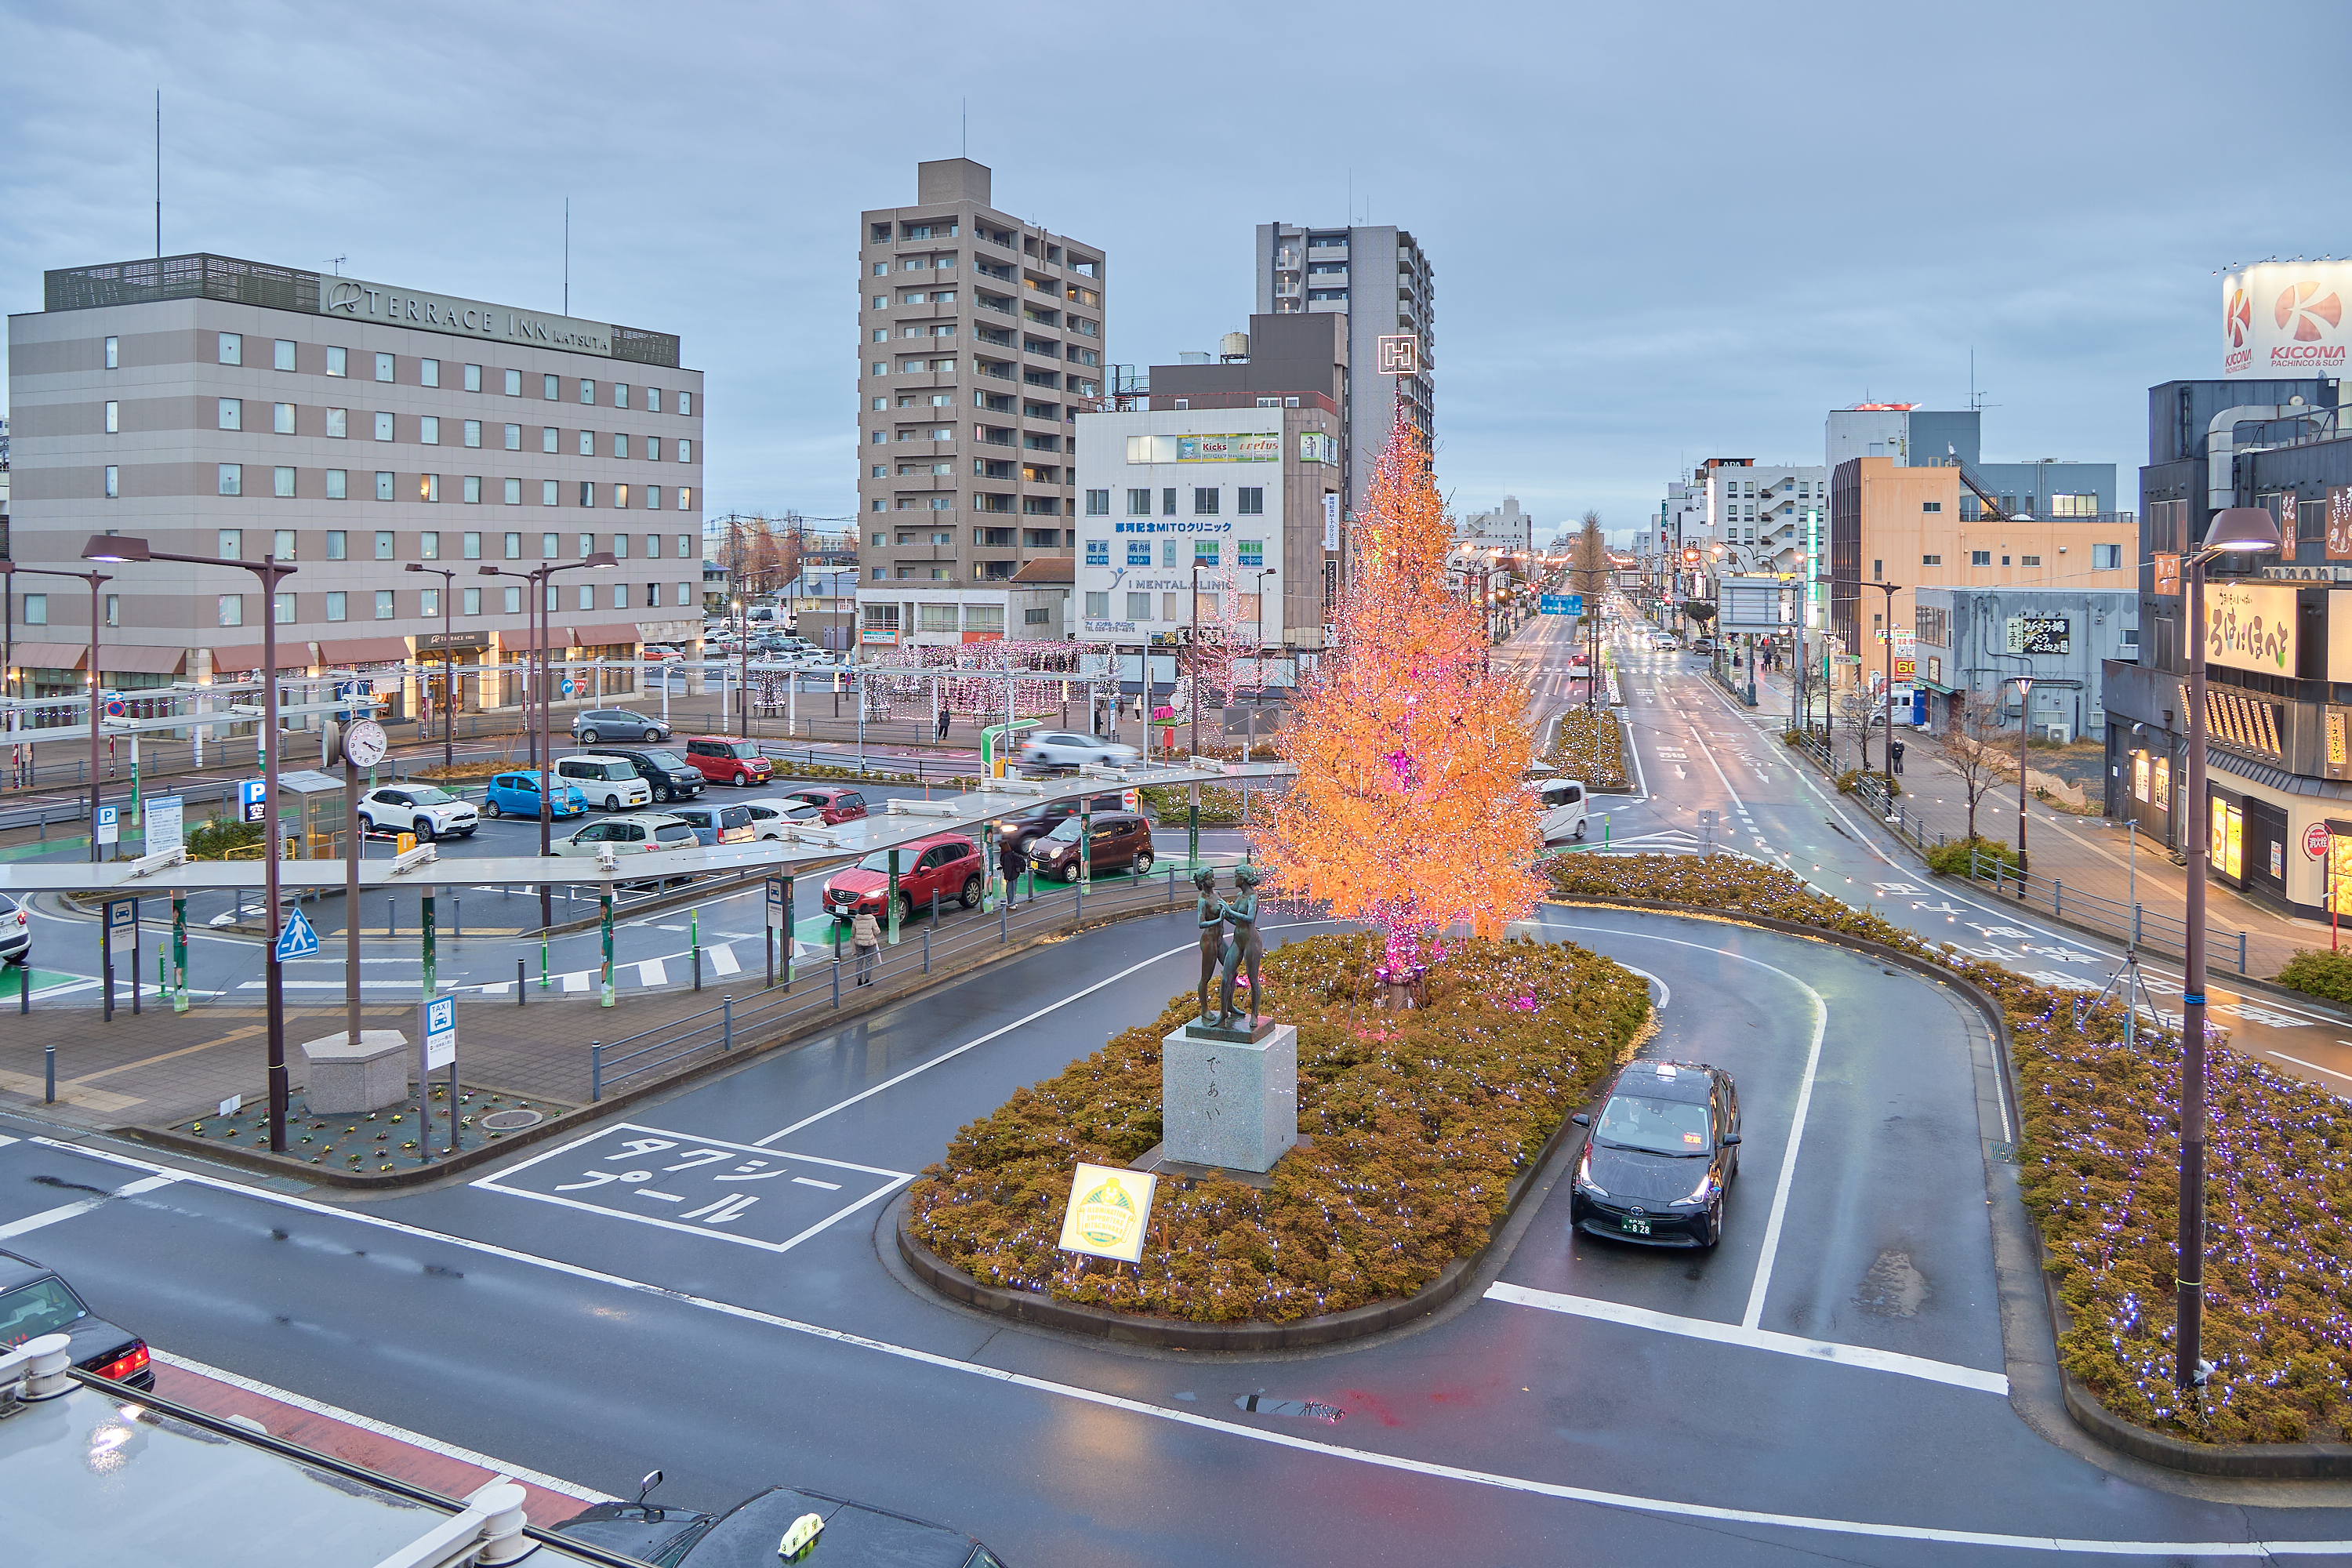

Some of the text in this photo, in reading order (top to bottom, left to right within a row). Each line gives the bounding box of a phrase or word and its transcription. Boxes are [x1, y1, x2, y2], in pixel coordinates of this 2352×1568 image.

[365, 288, 608, 350] TERRACE INN KATSUTA
[2225, 348, 2252, 368] KICONA
[2270, 346, 2346, 359] KICONA
[2225, 365, 2240, 375] PACHINCO
[1203, 442, 1227, 451] Kicks
[1116, 523, 1232, 533] 那珂記念MITOクリニック
[2024, 620, 2065, 633] あんこう鍋
[2024, 633, 2049, 643] あんこう
[2031, 643, 2060, 652] 水炊き
[251, 783, 266, 802] P
[104, 811, 112, 822] P
[2309, 836, 2328, 848] 消火栓
[432, 1002, 449, 1013] TAXI
[1207, 1057, 1221, 1120] であい
[1684, 1134, 1702, 1145] 空車
[604, 1138, 843, 1190] タクシー
[554, 1171, 760, 1223] プール
[1087, 1206, 1127, 1219] ILLUMINATION
[1087, 1214, 1124, 1227] SUPPORTERS
[1084, 1222, 1123, 1236] HITACHINAKA
